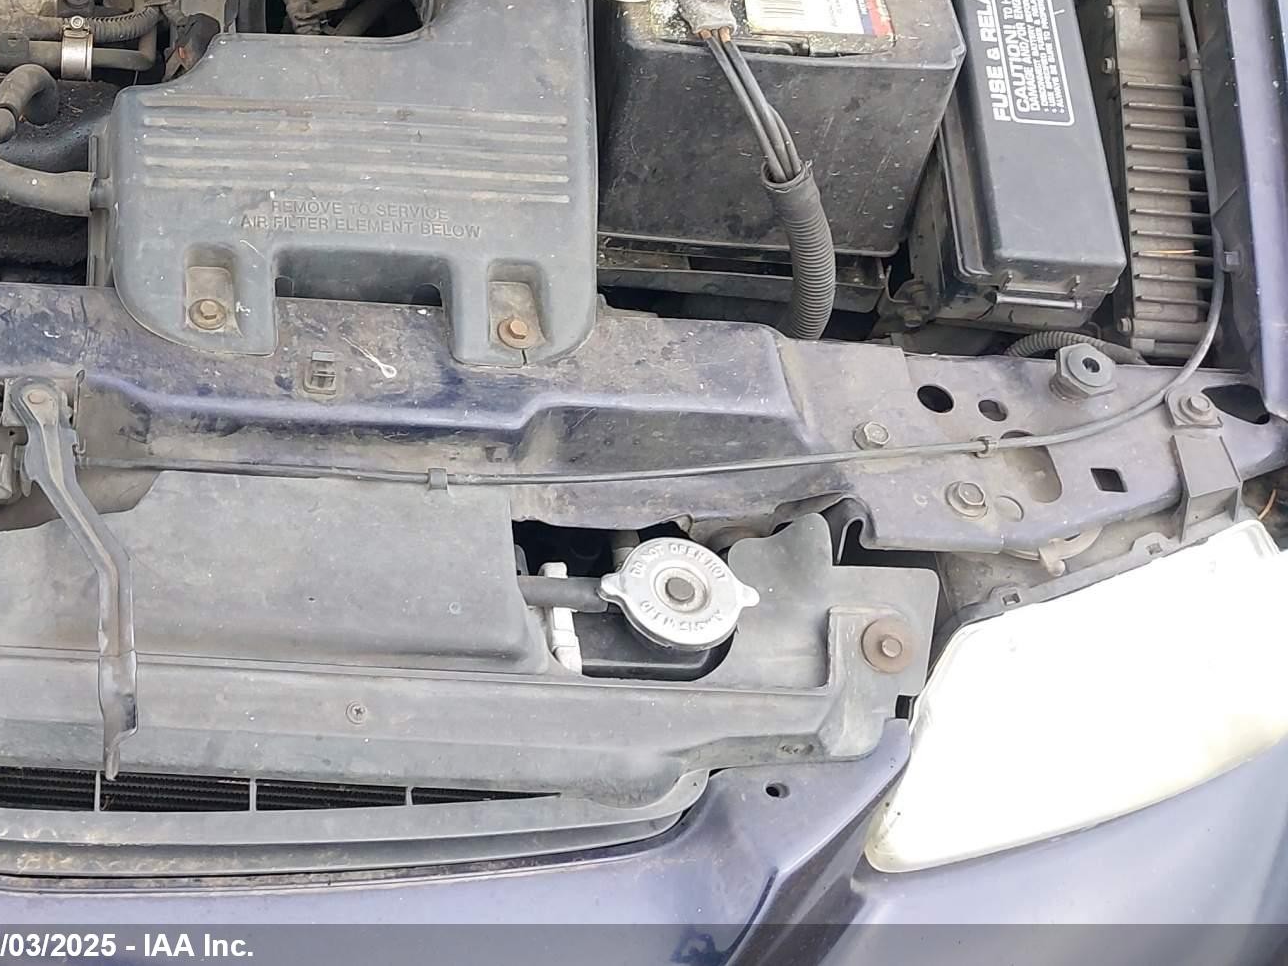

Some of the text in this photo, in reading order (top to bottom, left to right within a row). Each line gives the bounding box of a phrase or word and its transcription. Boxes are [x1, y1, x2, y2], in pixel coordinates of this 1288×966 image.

[1002, 6, 1014, 20] TO
[986, 47, 1001, 61] &
[1015, 22, 1033, 65] AND/OR
[1026, 24, 1040, 57] BATTERY
[1002, 24, 1031, 113] CAUTION!
[985, 65, 1012, 122] FUSE
[1023, 66, 1041, 112] DAMAGE
[271, 199, 450, 221] REMOVE TO SERVICE
[240, 214, 482, 240] AIR FILTER ELEMENT BELOW
